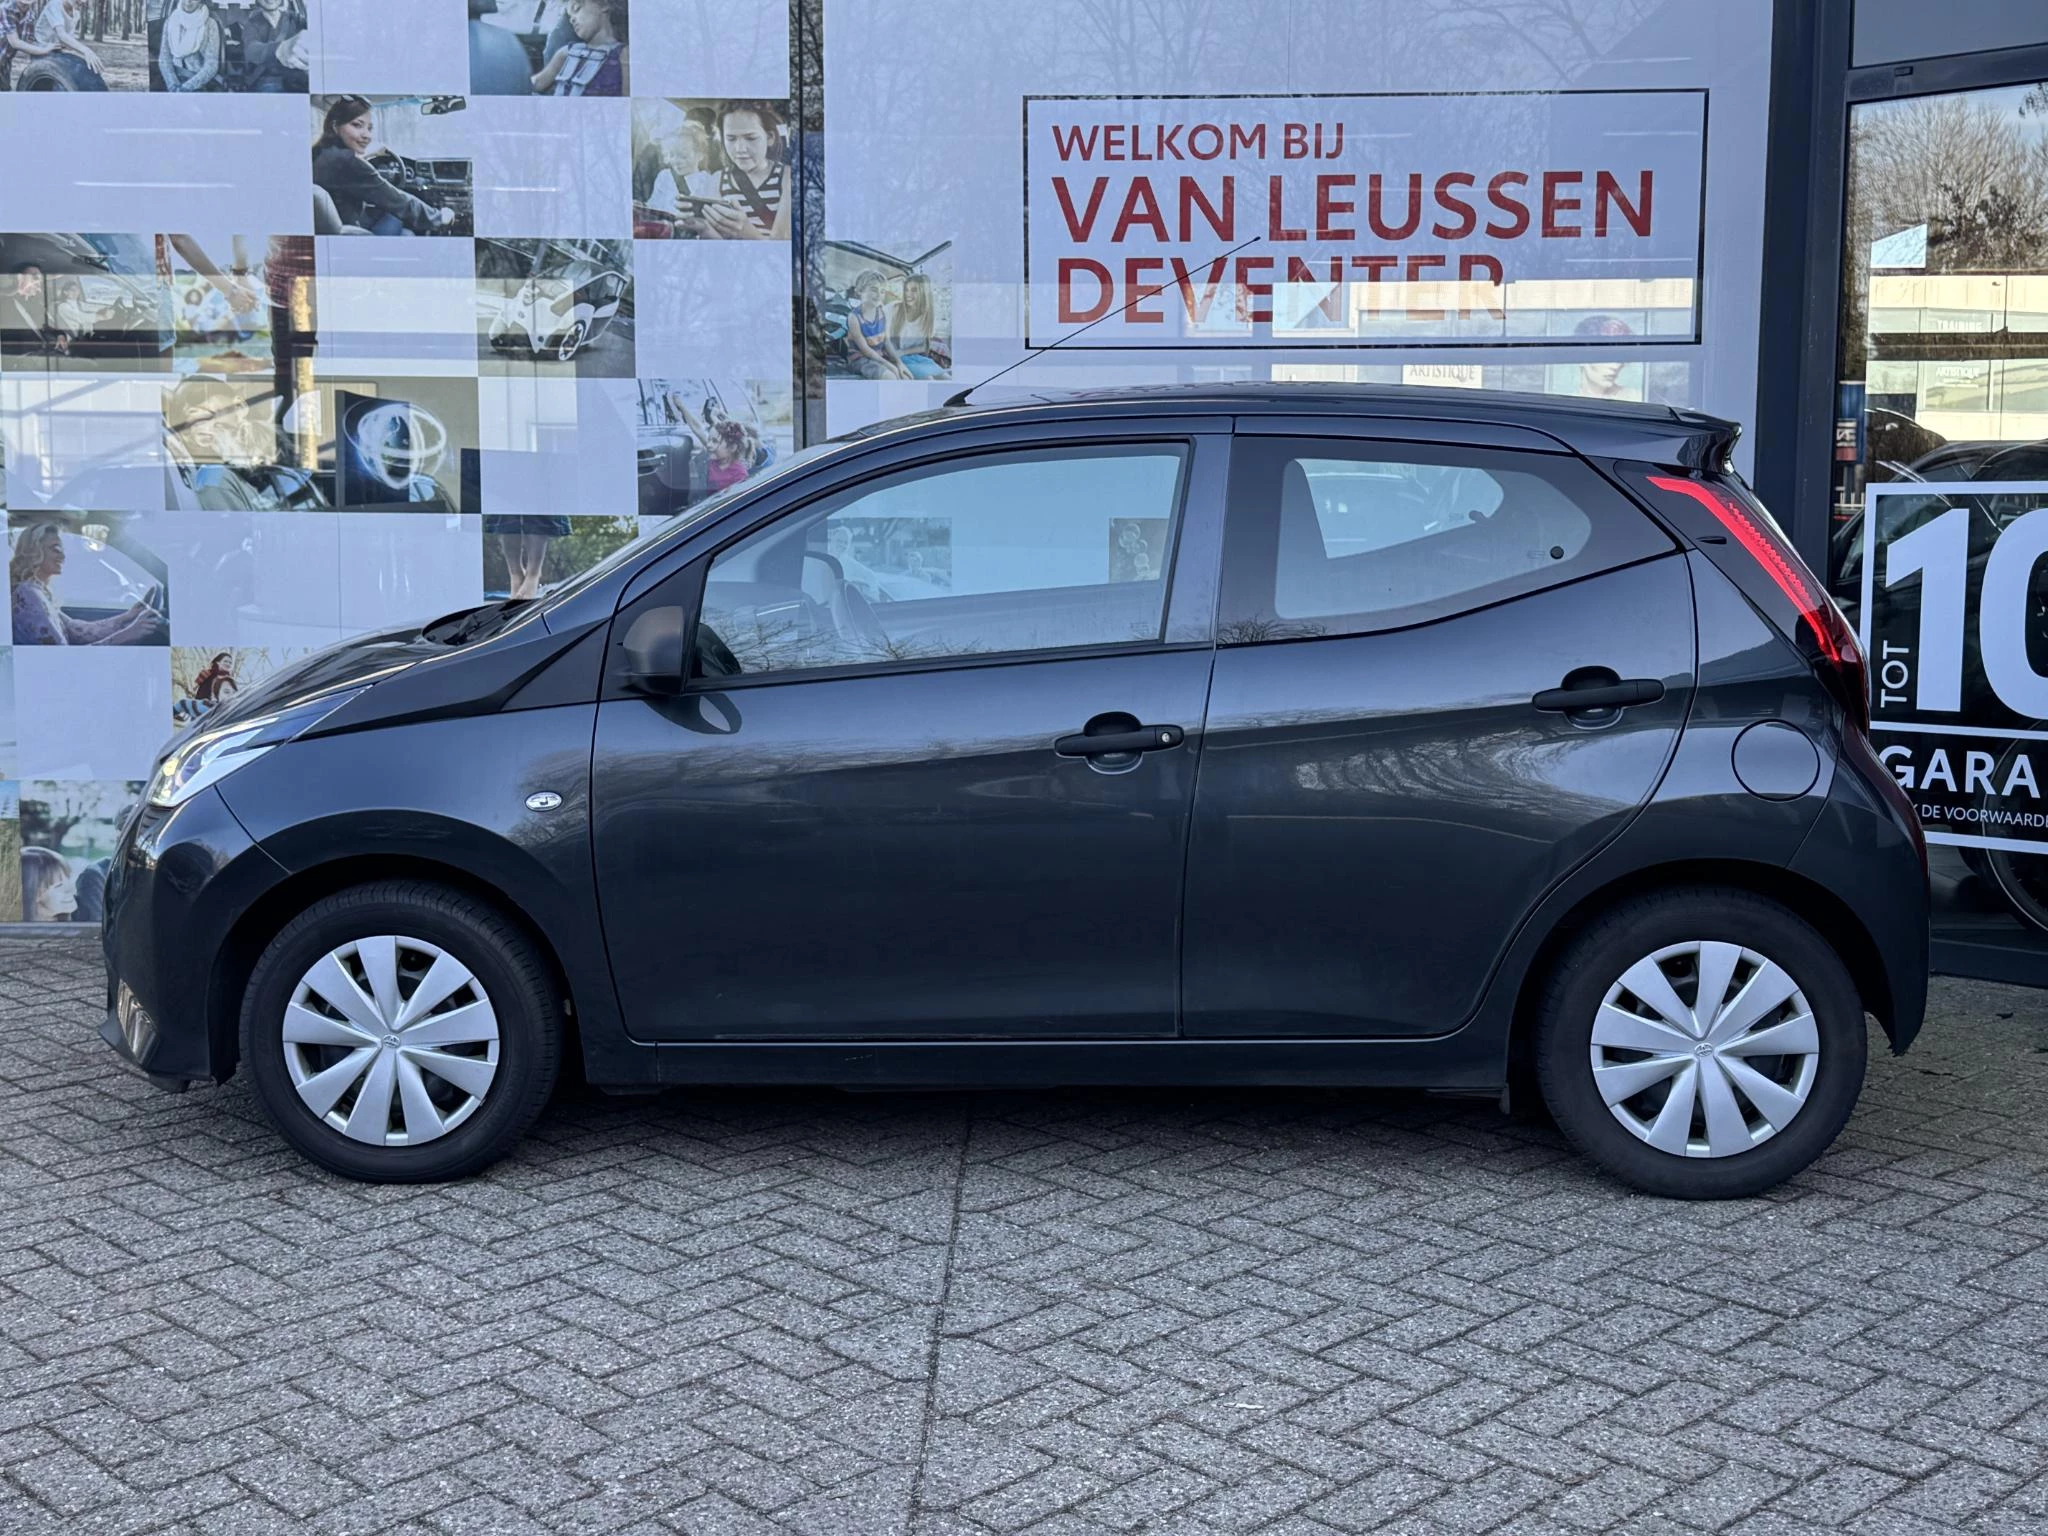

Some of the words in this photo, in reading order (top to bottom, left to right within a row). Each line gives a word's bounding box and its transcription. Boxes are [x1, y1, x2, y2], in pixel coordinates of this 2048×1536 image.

[1052, 123, 1267, 162] WELKOM
[1283, 122, 1344, 160] BIJ
[1052, 176, 1235, 243] VAN
[1268, 170, 1653, 241] LEUSSEN
[1057, 254, 1507, 324] DEVENTER
[1880, 639, 1910, 709] TOT
[1878, 744, 2041, 799] GARA
[1921, 804, 1942, 819] DE
